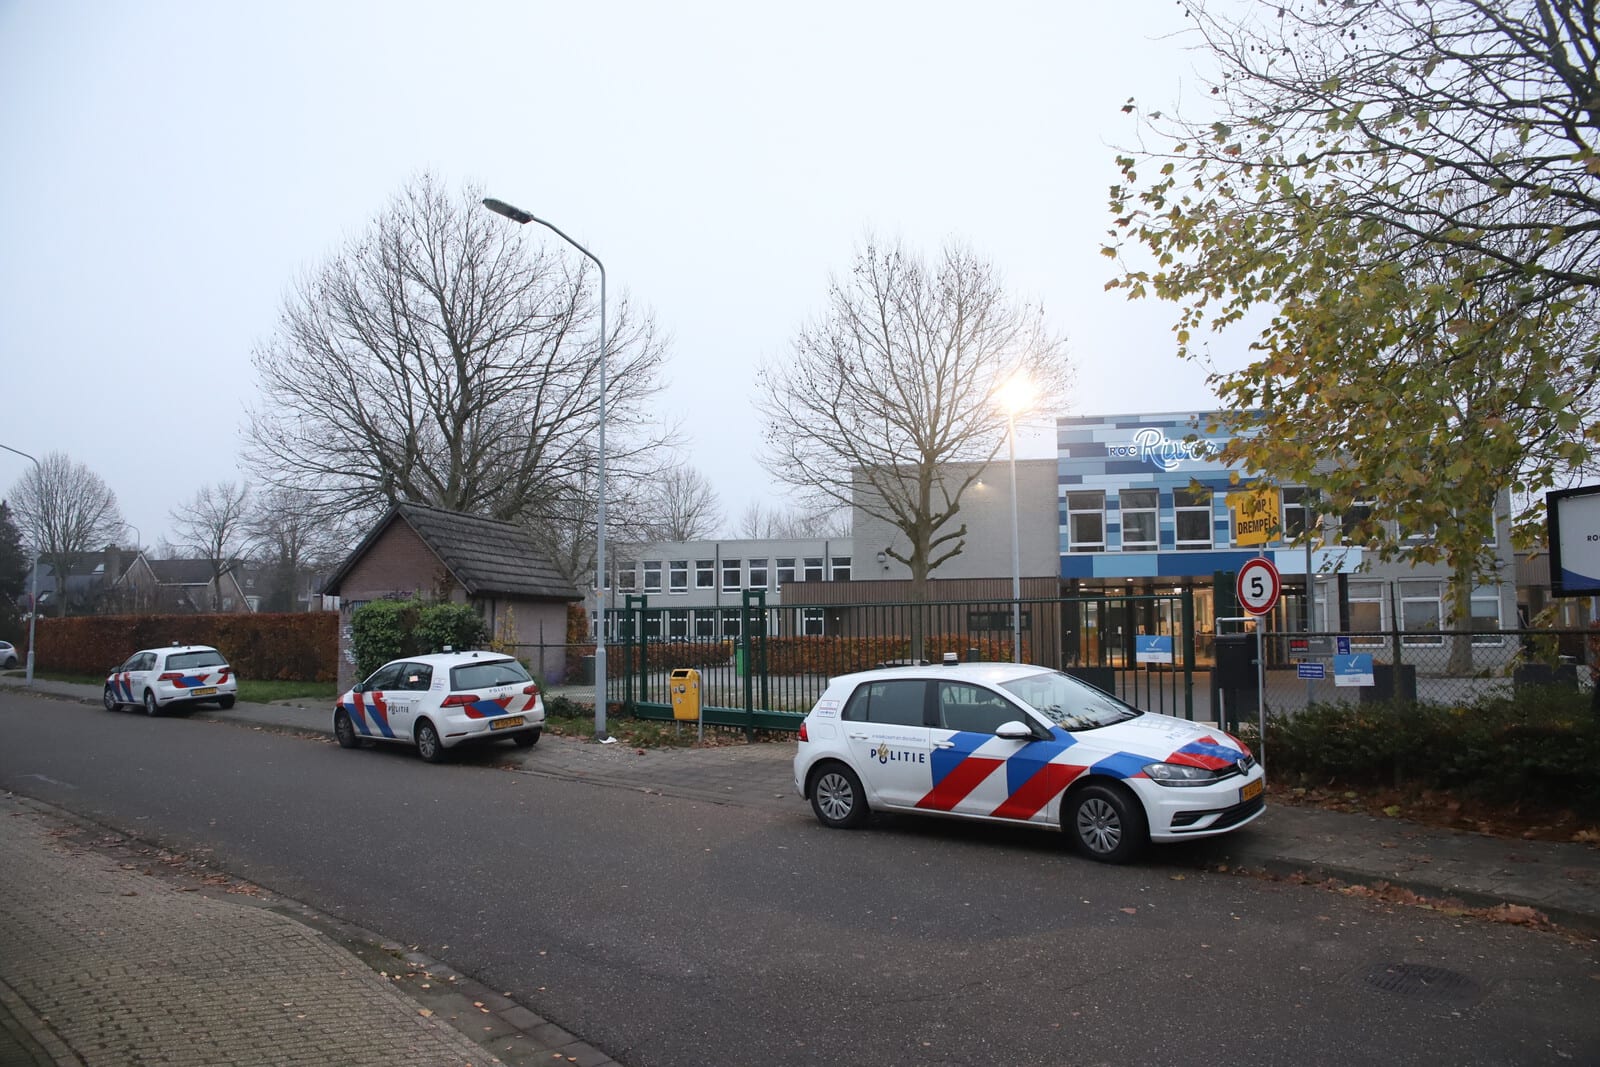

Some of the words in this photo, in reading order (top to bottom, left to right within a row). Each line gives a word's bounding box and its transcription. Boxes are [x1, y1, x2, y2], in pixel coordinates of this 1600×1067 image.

[1109, 447, 1137, 457] ROC
[1587, 534, 1600, 542] RO
[1251, 576, 1264, 598] 5
[870, 747, 925, 764] POLITIE
